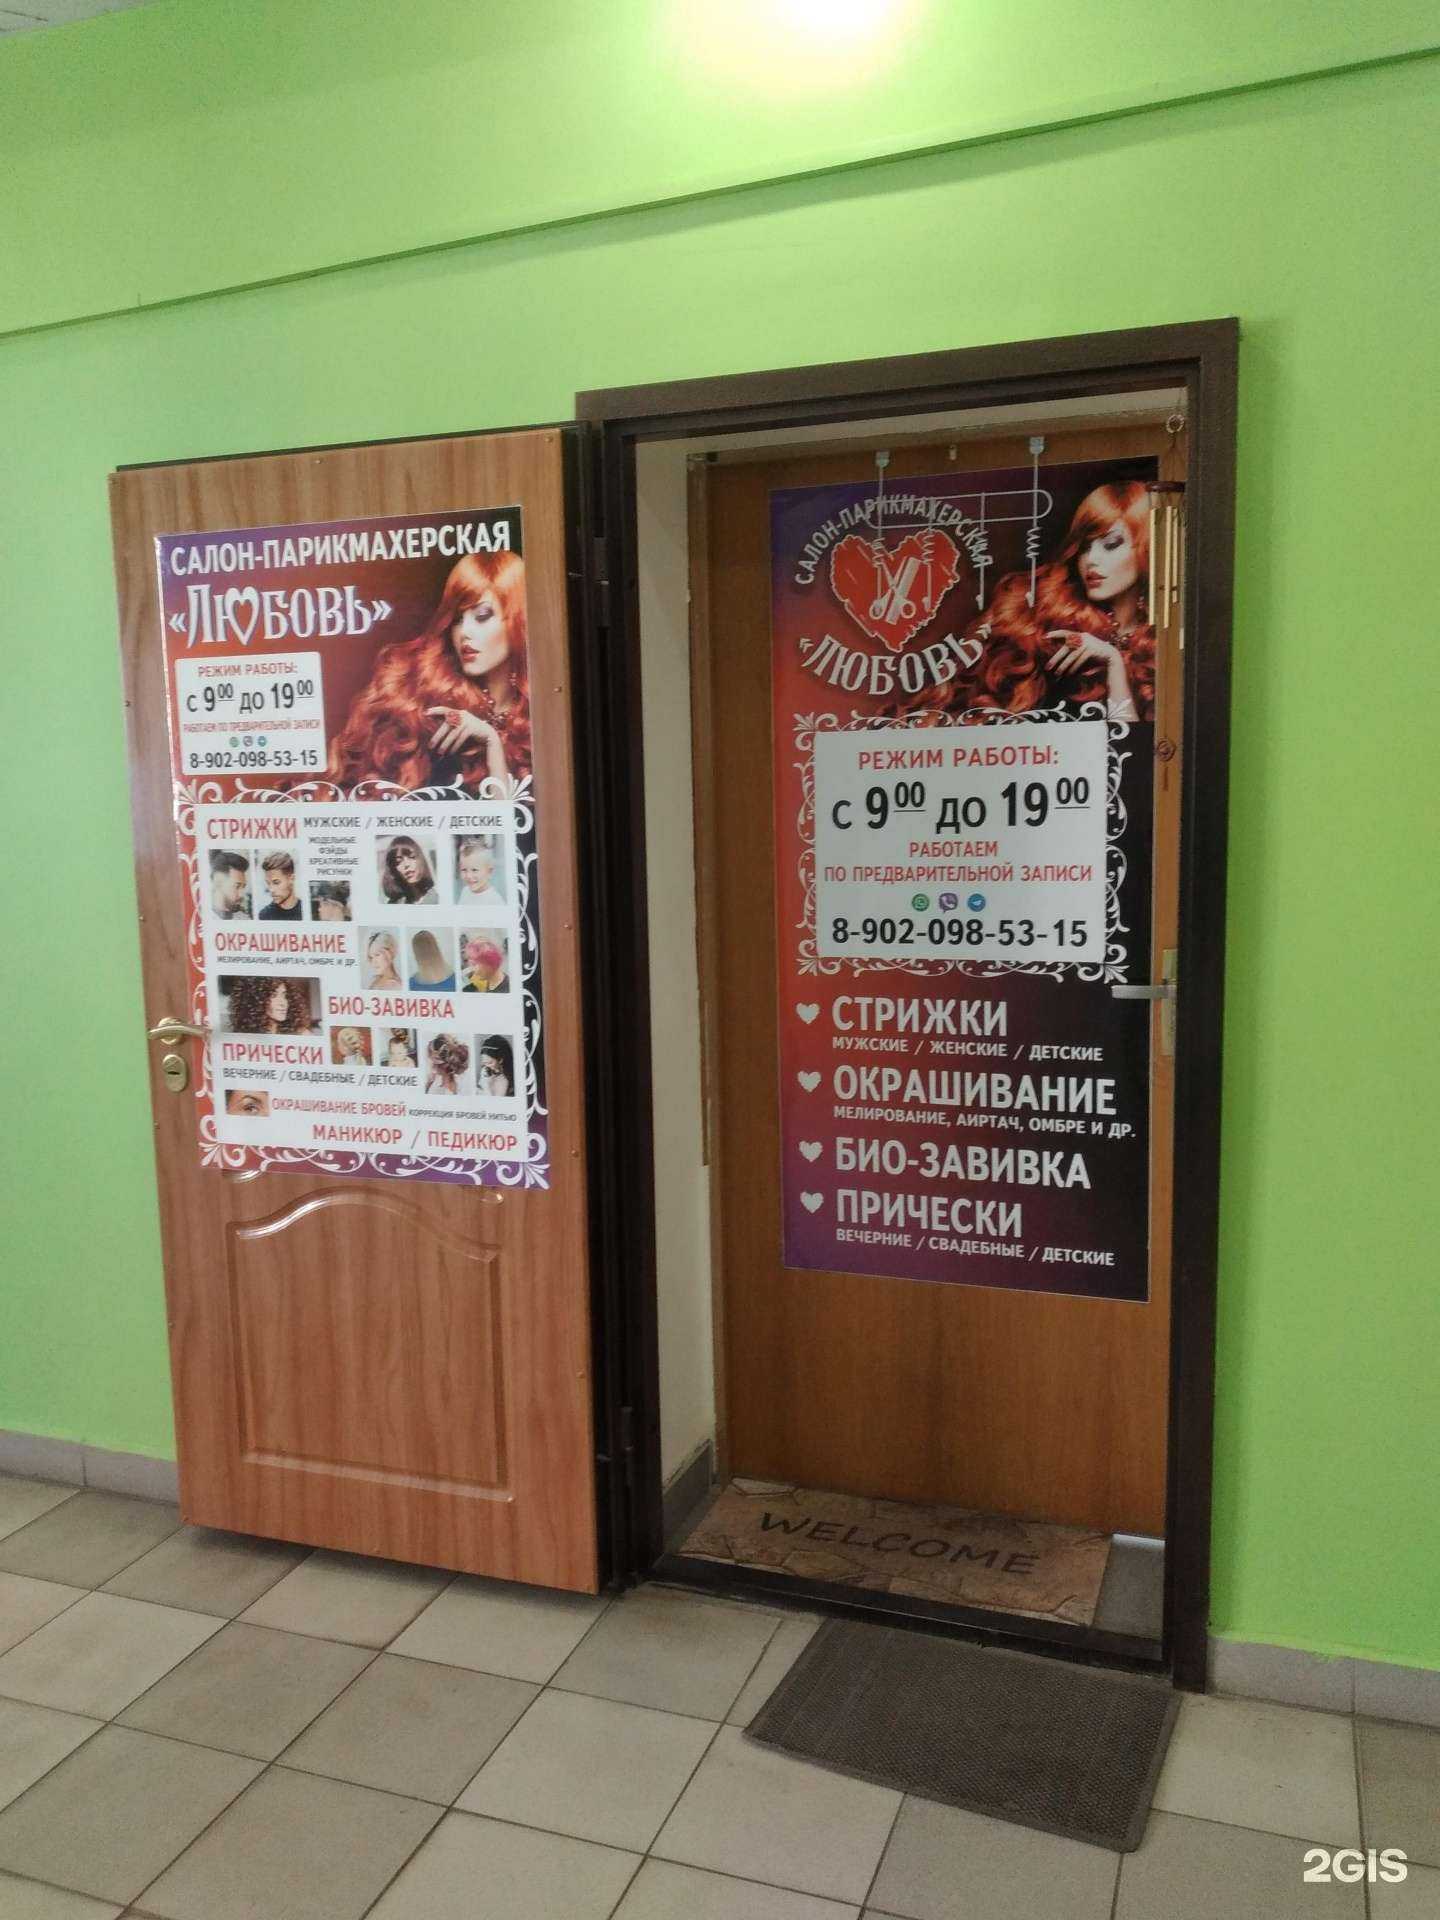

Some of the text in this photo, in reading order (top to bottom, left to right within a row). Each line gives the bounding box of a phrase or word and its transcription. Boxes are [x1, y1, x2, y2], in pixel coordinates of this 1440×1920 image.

[170, 521, 511, 576] САЛОН-ПАРИКМАХЕРСКАЯ
[794, 493, 993, 585] САЛОН-ПАРИКМАХЕРСКАЯ
[198, 661, 298, 677] РЕЖИМ РАБОТЫ:
[190, 749, 318, 769] 8-902-098-53-15
[858, 745, 1059, 770] РЕЖИМ РАБОТЫ:
[207, 817, 298, 840] СТРИЖКИ
[303, 816, 361, 828] МУЖСКИЕ
[376, 816, 434, 828] ЖЕНСКИЕ
[449, 816, 503, 829] ДЕТСКИЕ
[909, 841, 998, 858] РАБОТАЕМ
[824, 861, 1093, 884] ПО ПРЕДВАРИТЕЛЬНОЙ ЗАПИСИ
[215, 932, 346, 953] ОКРАШИВАНИЕ
[831, 918, 1089, 947] 8-902-098-53-15
[328, 996, 455, 1019] БИО-ЗАВИВКА
[831, 995, 1008, 1037] СТРИЖКИ
[222, 1042, 324, 1066] ПРИЧЕСКИ
[832, 1037, 909, 1053] МУЖСКИЕ
[930, 1040, 1007, 1057] ЖЕНСКИЕ
[1028, 1044, 1103, 1062] ДЕТСКИЕ
[223, 1067, 277, 1080] ВЕЧЕРНИЕ
[288, 1070, 356, 1084] СВАДЕБНЫЕ
[367, 1074, 418, 1087] ДЕТСКИЕ
[833, 1064, 1117, 1115] ОКРАШИВАНИЕ
[271, 1097, 407, 1117] ОКРАШИВАНИЕ БРОВЕЙ
[834, 1105, 1136, 1139] МЕЛИРОВАНИЕ, АИРТАЧ, ОМБРЕ И ДР.
[313, 1124, 402, 1145] МАНИКЮР
[427, 1131, 518, 1152] ПЕДИКЮР
[835, 1136, 1092, 1190] БИО-ЗАВИВКА
[836, 1189, 1023, 1238] ПРИЧЕСКИ
[836, 1228, 912, 1247] ВЕЧЕРНИЕ
[928, 1236, 1024, 1258] СВАДЕБНЫЕ
[1042, 1247, 1115, 1266] ДЕТСКИЕ
[760, 1511, 1040, 1575] WELCOME
